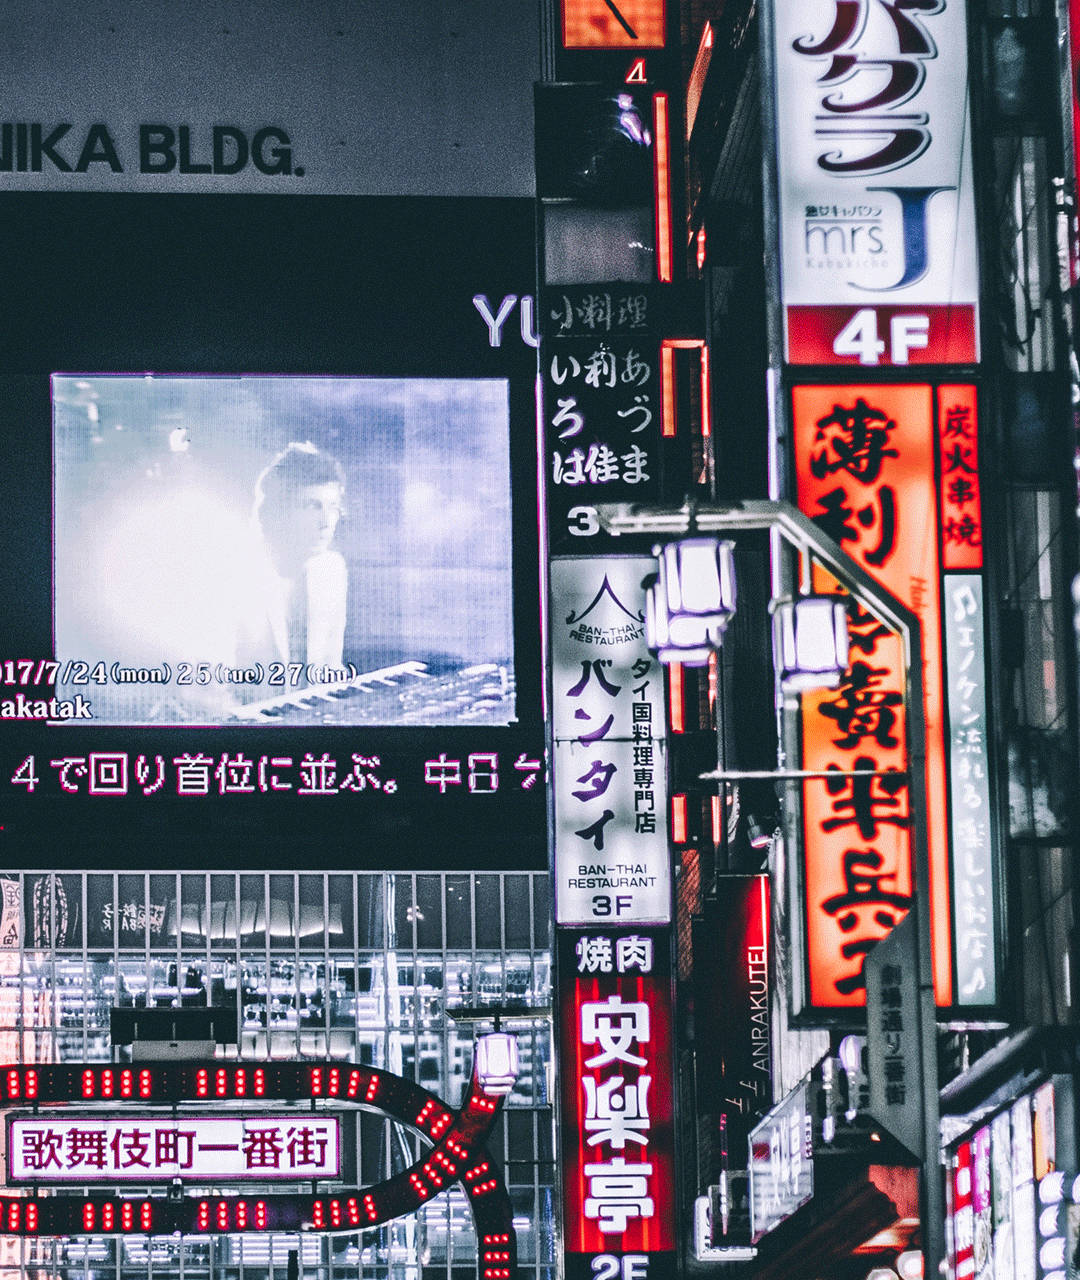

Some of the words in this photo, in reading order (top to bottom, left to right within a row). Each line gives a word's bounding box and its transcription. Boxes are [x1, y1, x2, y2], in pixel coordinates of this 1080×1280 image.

[625, 58, 648, 83] 4
[138, 125, 306, 177] BLDG.
[832, 307, 930, 366] 4F
[945, 404, 983, 548] 炭火串焼
[569, 627, 646, 646] RESTAURANT
[578, 623, 636, 636] BAN-THAI
[566, 658, 621, 850] バンタイ
[630, 657, 656, 835] タイ国料理専門店
[567, 876, 658, 890] RESTAURANT
[578, 863, 648, 877] BAN-THAI
[591, 894, 634, 917] 3F
[576, 935, 653, 974] 焼肉
[747, 944, 771, 1073] ANRAKUTEI
[580, 994, 655, 1235] 安楽亭
[20, 1127, 330, 1171] 歌舞伎町一番街
